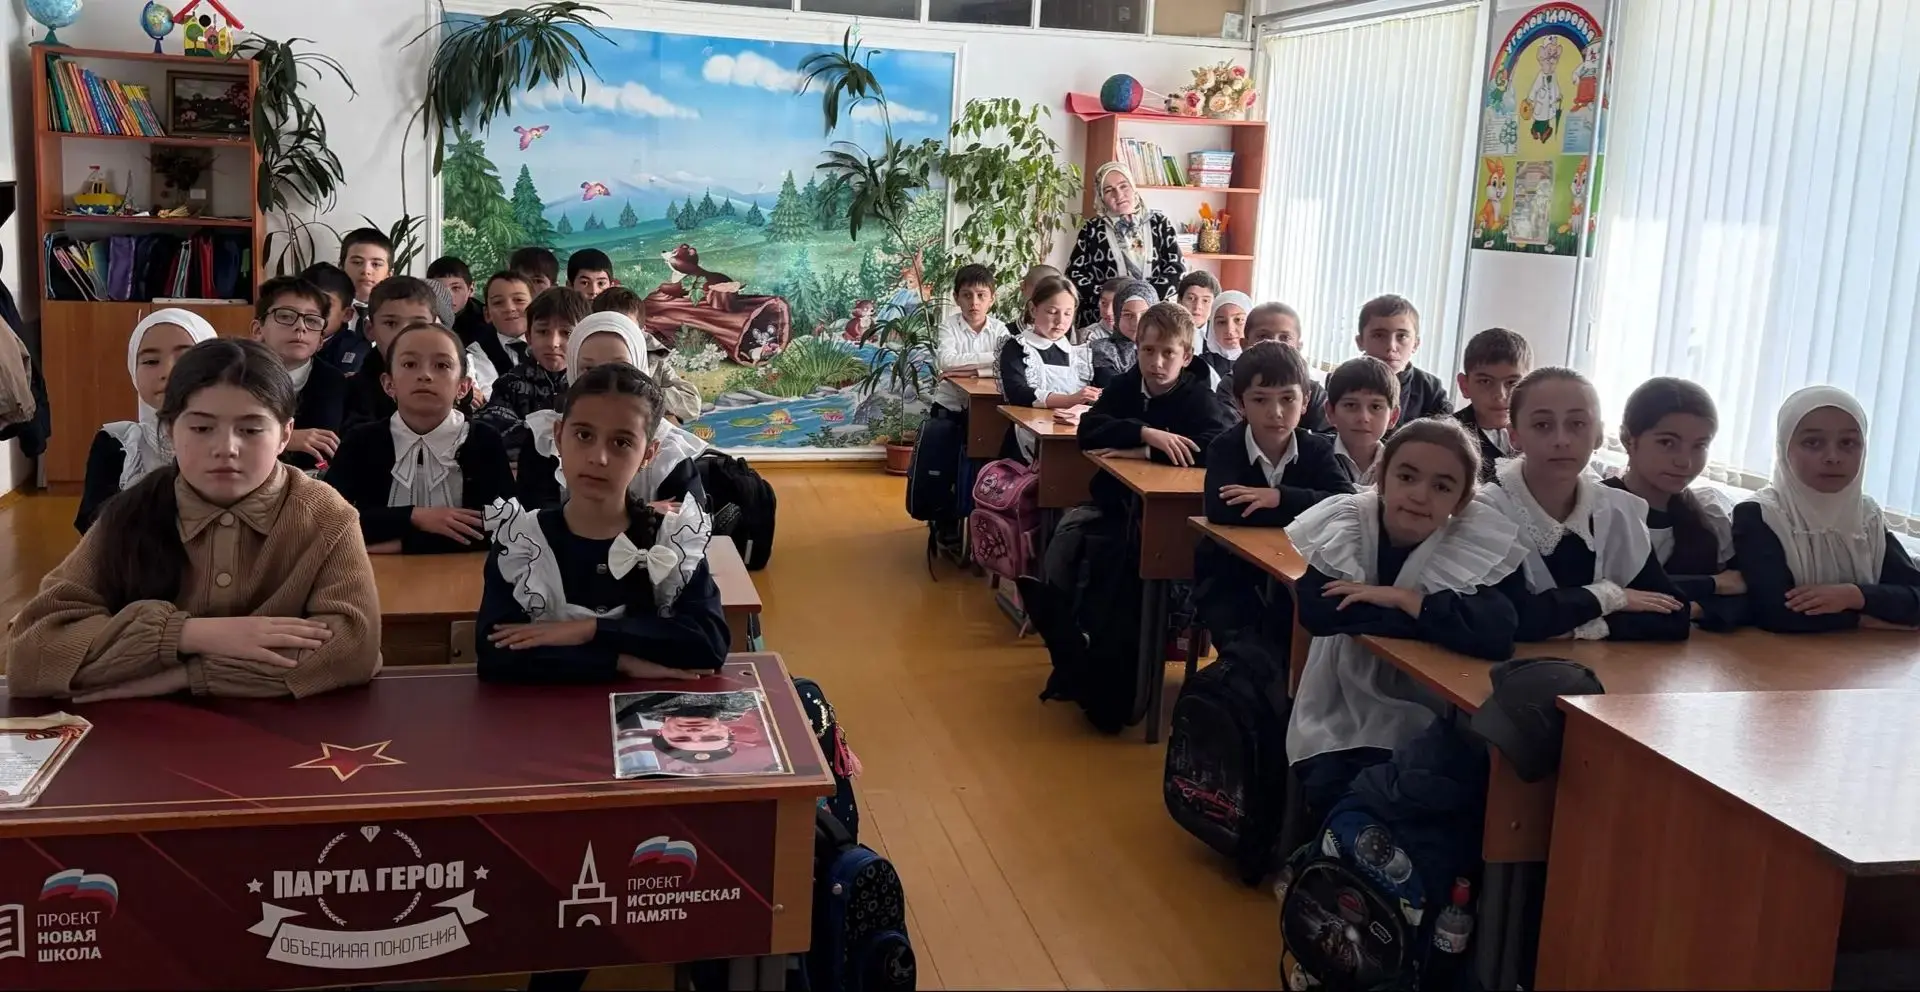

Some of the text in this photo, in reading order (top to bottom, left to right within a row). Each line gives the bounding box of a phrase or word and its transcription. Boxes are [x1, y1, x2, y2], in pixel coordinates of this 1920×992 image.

[273, 860, 465, 899] ПАРТА ГЕРОЯ
[627, 875, 682, 891] ПРОЕКТ
[627, 887, 741, 908] ИСТОРИЧЕСКАЯ
[37, 911, 101, 928] ПРОЕКТ
[626, 908, 688, 924] ПАМЯТЬ
[37, 929, 97, 945] НОВАЯ
[280, 925, 457, 960] ОБЪЕДИНЯЯ ПОКОЛЕНИЯ
[37, 946, 102, 963] ШКОЛА
